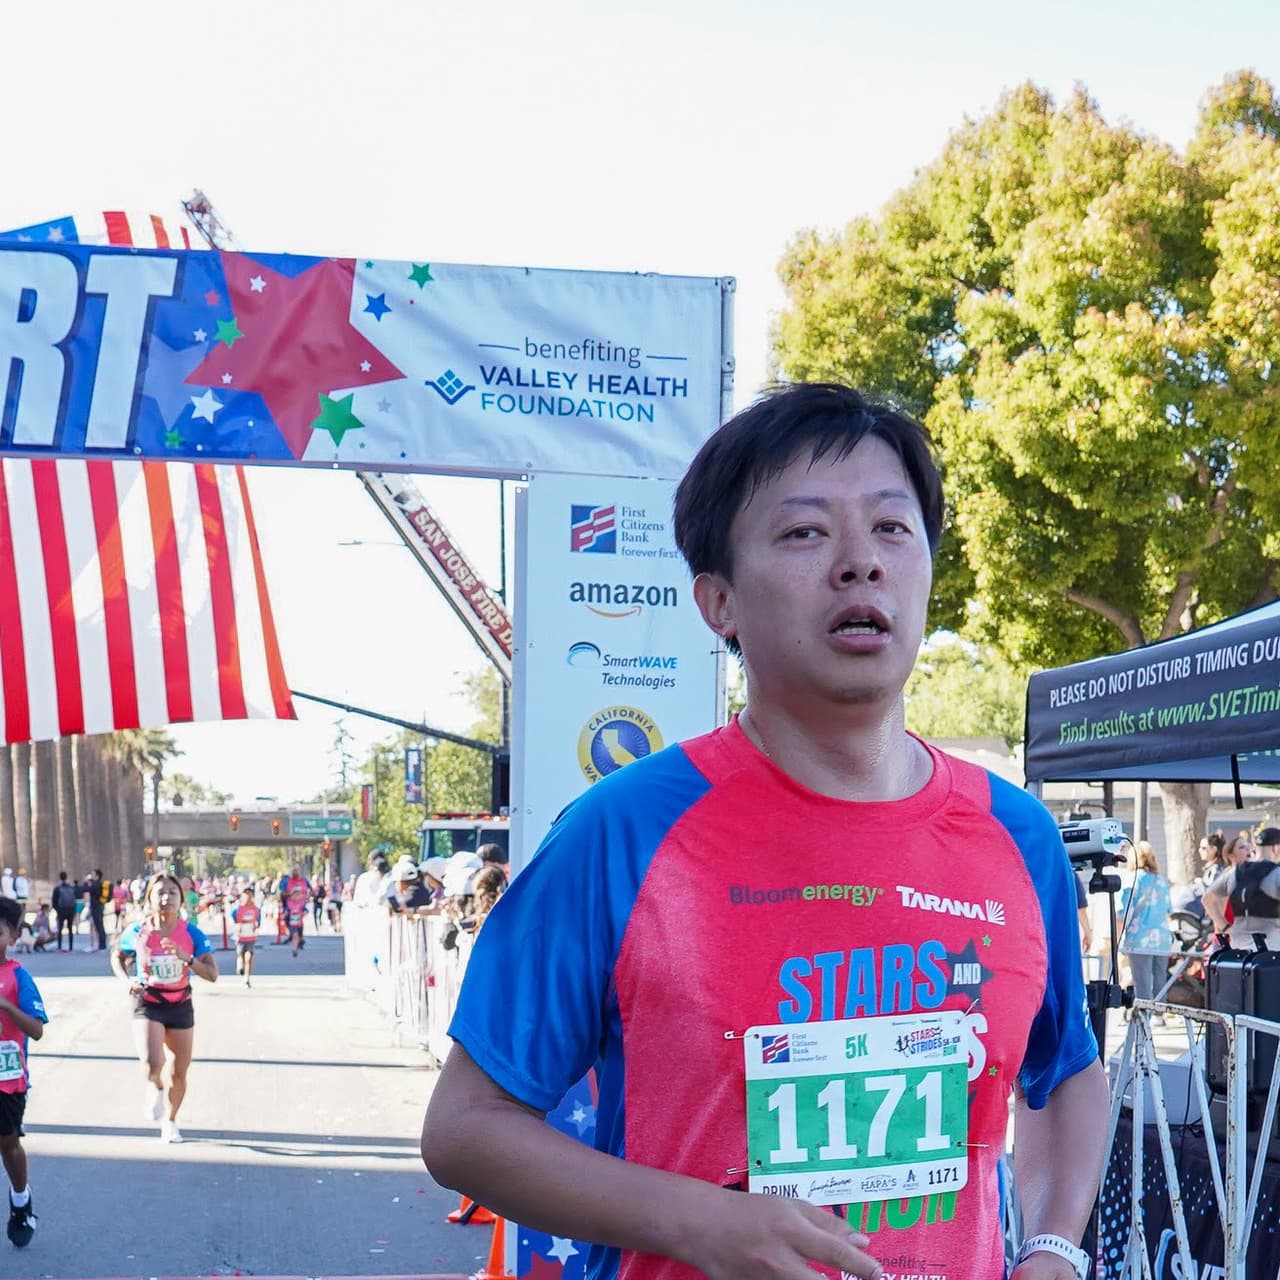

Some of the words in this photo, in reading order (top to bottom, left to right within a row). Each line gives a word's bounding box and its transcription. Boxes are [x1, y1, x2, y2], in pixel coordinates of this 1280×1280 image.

[524, 336, 642, 368] benefiting
[479, 366, 579, 391] VALLEY
[587, 374, 689, 397] HEALTH
[481, 393, 654, 423] FOUNDATION
[621, 506, 646, 518] First
[621, 519, 665, 532] Citizens
[621, 532, 649, 543] Bank
[621, 546, 657, 558] forever
[414, 511, 445, 547] SAN
[438, 545, 478, 590] JOSE
[470, 586, 506, 629] FIRE
[569, 582, 678, 607] amazon
[602, 654, 679, 670] SmartWAVE
[601, 673, 677, 690] Technologies
[1050, 686, 1088, 709] PLEASE
[1088, 679, 1107, 700] DO
[1108, 670, 1136, 694] NOT
[1136, 657, 1191, 691] DISTURB
[1194, 644, 1250, 675] TIMING
[588, 709, 655, 734] CALIFORNIA
[1058, 719, 1088, 746] Find
[1090, 709, 1136, 742] results
[1138, 706, 1155, 731] at
[895, 885, 987, 922] TARANA
[778, 939, 949, 1025] STARS
[951, 962, 982, 985] AND
[845, 1033, 869, 1060] 5K
[909, 1026, 936, 1043] STARS
[910, 1037, 943, 1055] STRIDES
[767, 1070, 951, 1165] 1171
[927, 1167, 959, 1186] 1171
[762, 1182, 800, 1199] DRINK
[876, 1254, 927, 1272] enefiting
